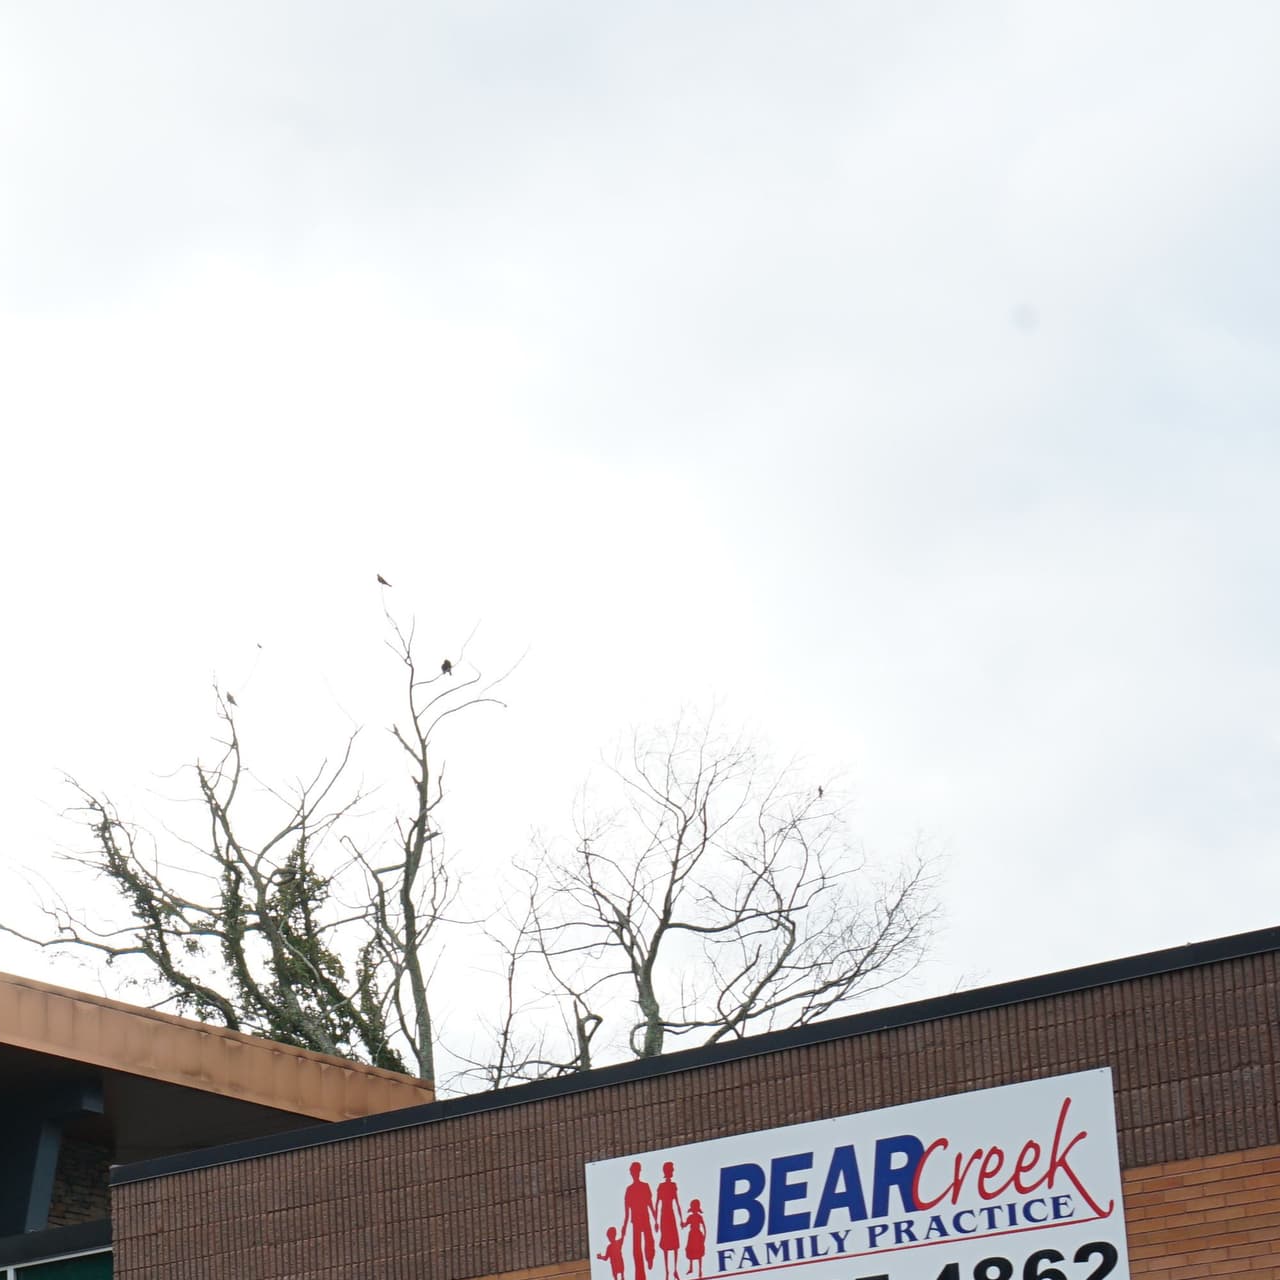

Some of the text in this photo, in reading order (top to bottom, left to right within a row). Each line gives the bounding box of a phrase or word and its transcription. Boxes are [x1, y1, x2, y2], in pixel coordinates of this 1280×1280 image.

[716, 1097, 1115, 1244] BEAR Creek
[717, 1194, 1075, 1272] FAMILY PRACTICE
